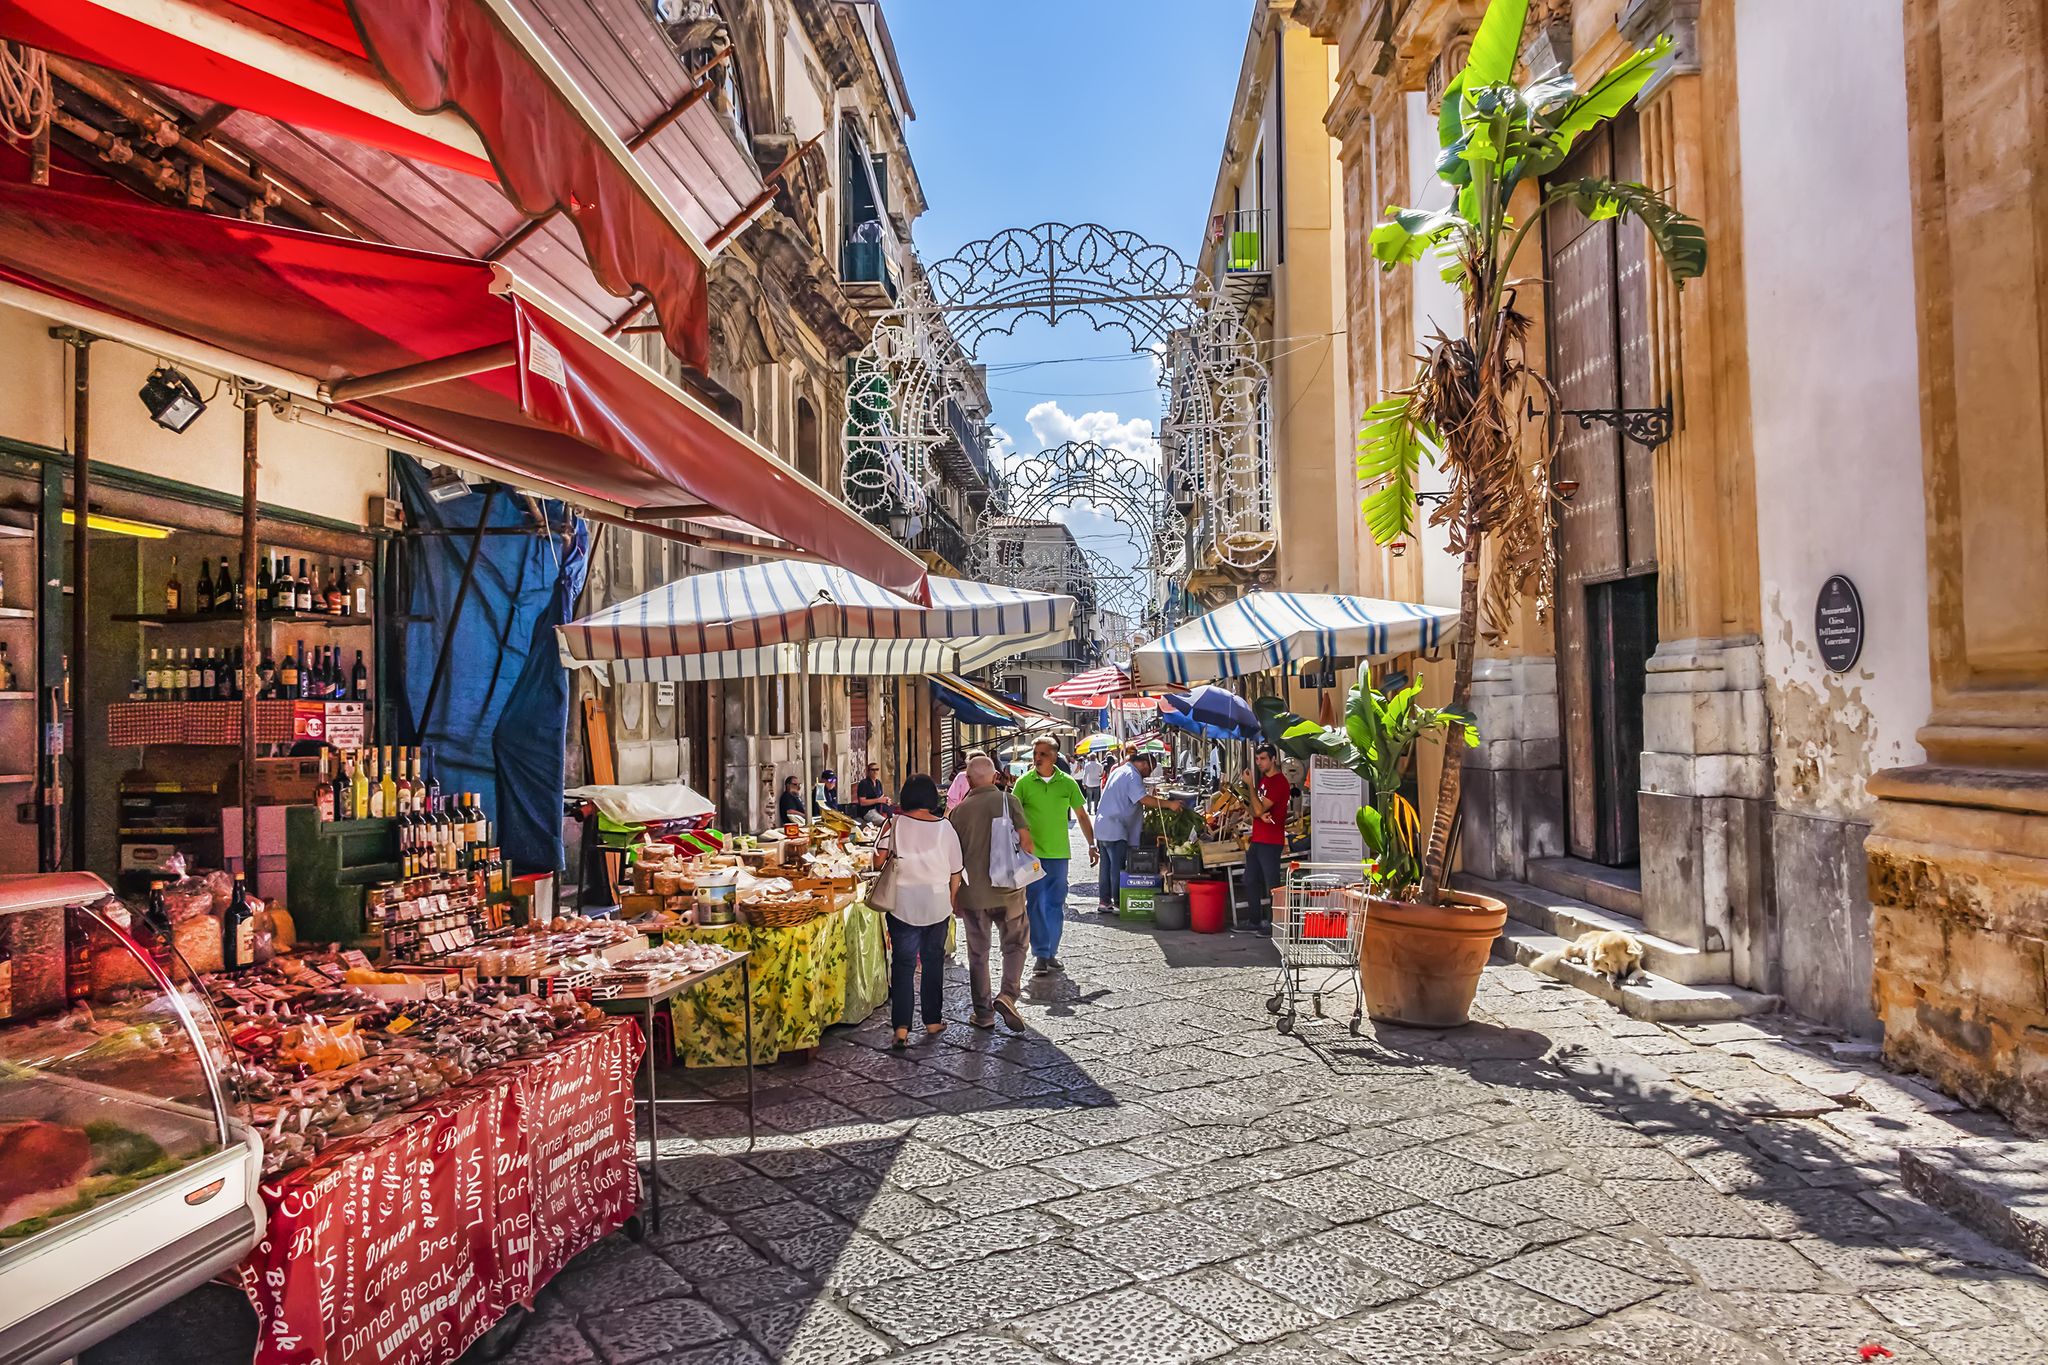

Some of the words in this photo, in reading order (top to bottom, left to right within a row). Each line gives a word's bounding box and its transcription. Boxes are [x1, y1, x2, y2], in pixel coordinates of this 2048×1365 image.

[362, 1164, 375, 1239] Break
[379, 1152, 402, 1224] Coffee
[419, 1158, 440, 1230] Break
[550, 1195, 567, 1215] Fast
[569, 1162, 588, 1219] Break
[581, 1160, 599, 1215] Coffee
[366, 1219, 416, 1271] Dinner
[265, 1267, 302, 1351] Break
[341, 1236, 355, 1324] Dinner
[365, 1260, 408, 1303] Coffee
[342, 1302, 396, 1361] Dinner
[376, 1313, 420, 1361] Lunch
